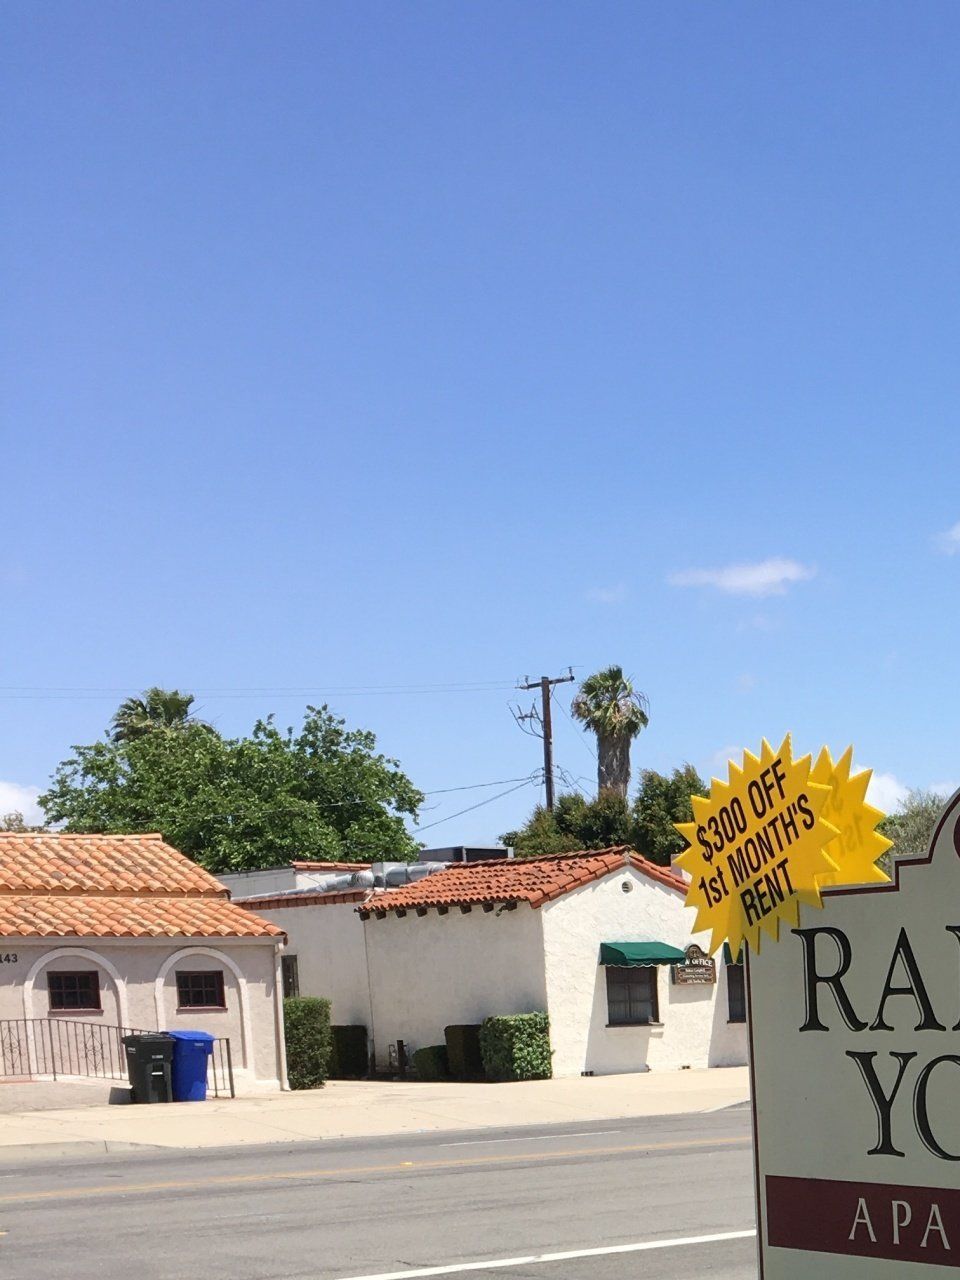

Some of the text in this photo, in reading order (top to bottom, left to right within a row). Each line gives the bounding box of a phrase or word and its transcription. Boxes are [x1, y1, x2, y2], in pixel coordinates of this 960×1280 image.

[696, 796, 748, 865] $300
[747, 758, 786, 819] OFF
[698, 865, 729, 909] 1st
[726, 793, 815, 887] MONTH'S
[739, 858, 795, 926] RENT
